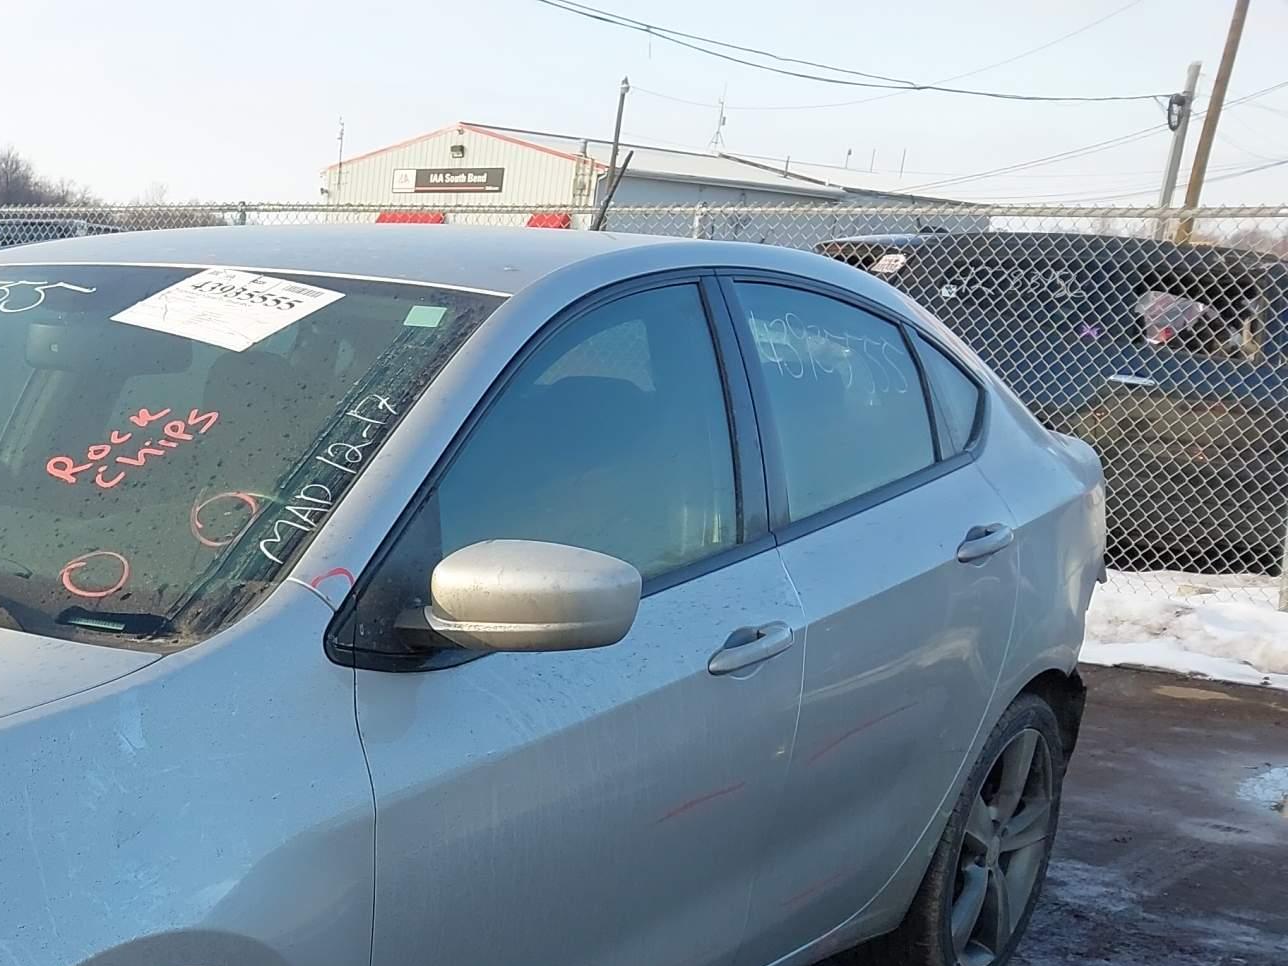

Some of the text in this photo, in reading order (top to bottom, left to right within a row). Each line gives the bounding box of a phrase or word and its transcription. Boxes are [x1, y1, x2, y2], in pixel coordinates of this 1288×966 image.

[429, 172, 488, 184] IAA South Bend
[191, 280, 304, 312] 43935555
[259, 393, 399, 565] MAD 12-17
